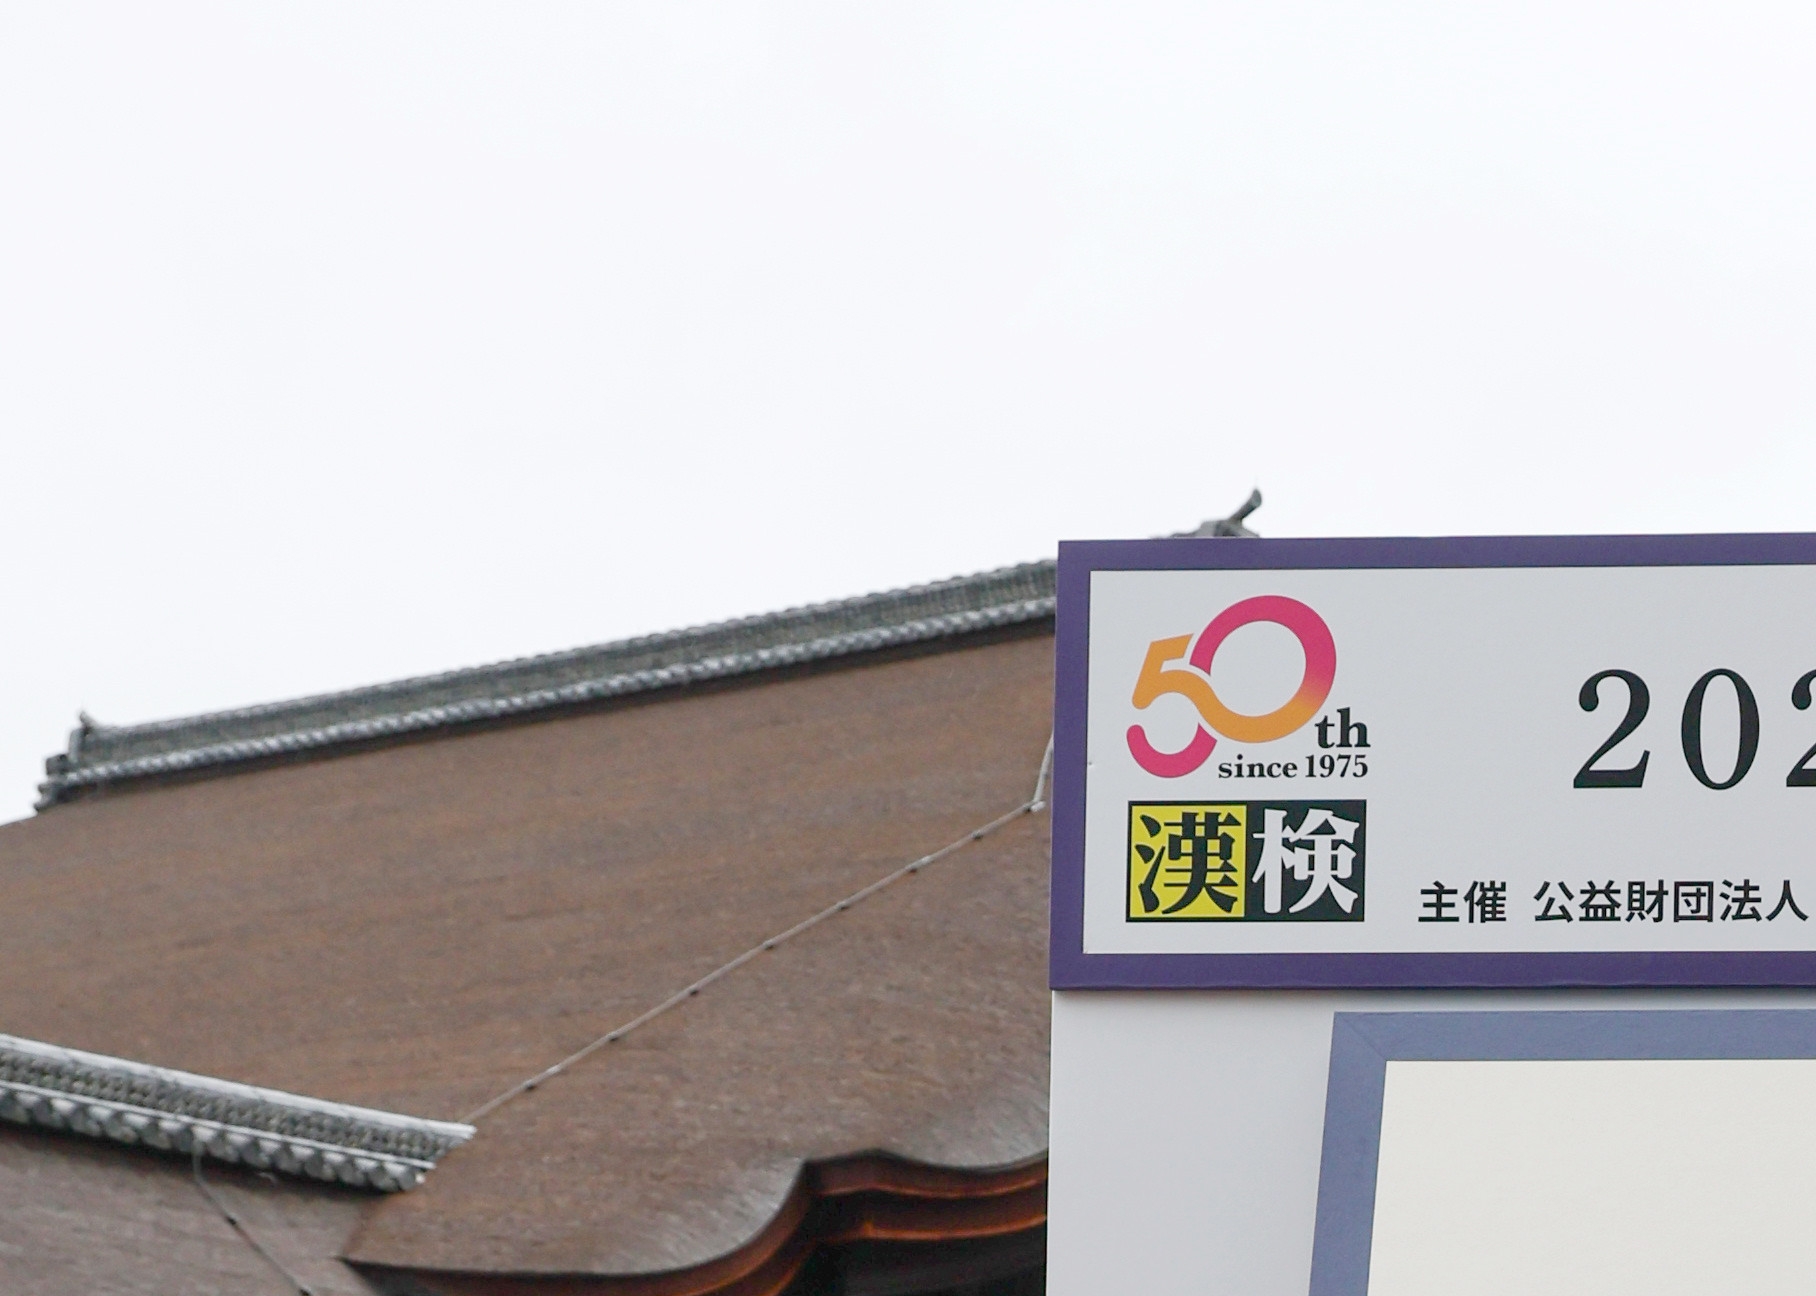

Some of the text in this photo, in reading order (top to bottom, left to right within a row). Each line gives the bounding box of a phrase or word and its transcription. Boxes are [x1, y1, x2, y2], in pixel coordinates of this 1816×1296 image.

[1218, 753, 1368, 779] since 1975
[1134, 808, 1360, 915] 漢検
[1417, 880, 1507, 924] 主催
[1533, 878, 1809, 923] 公益財団法人
